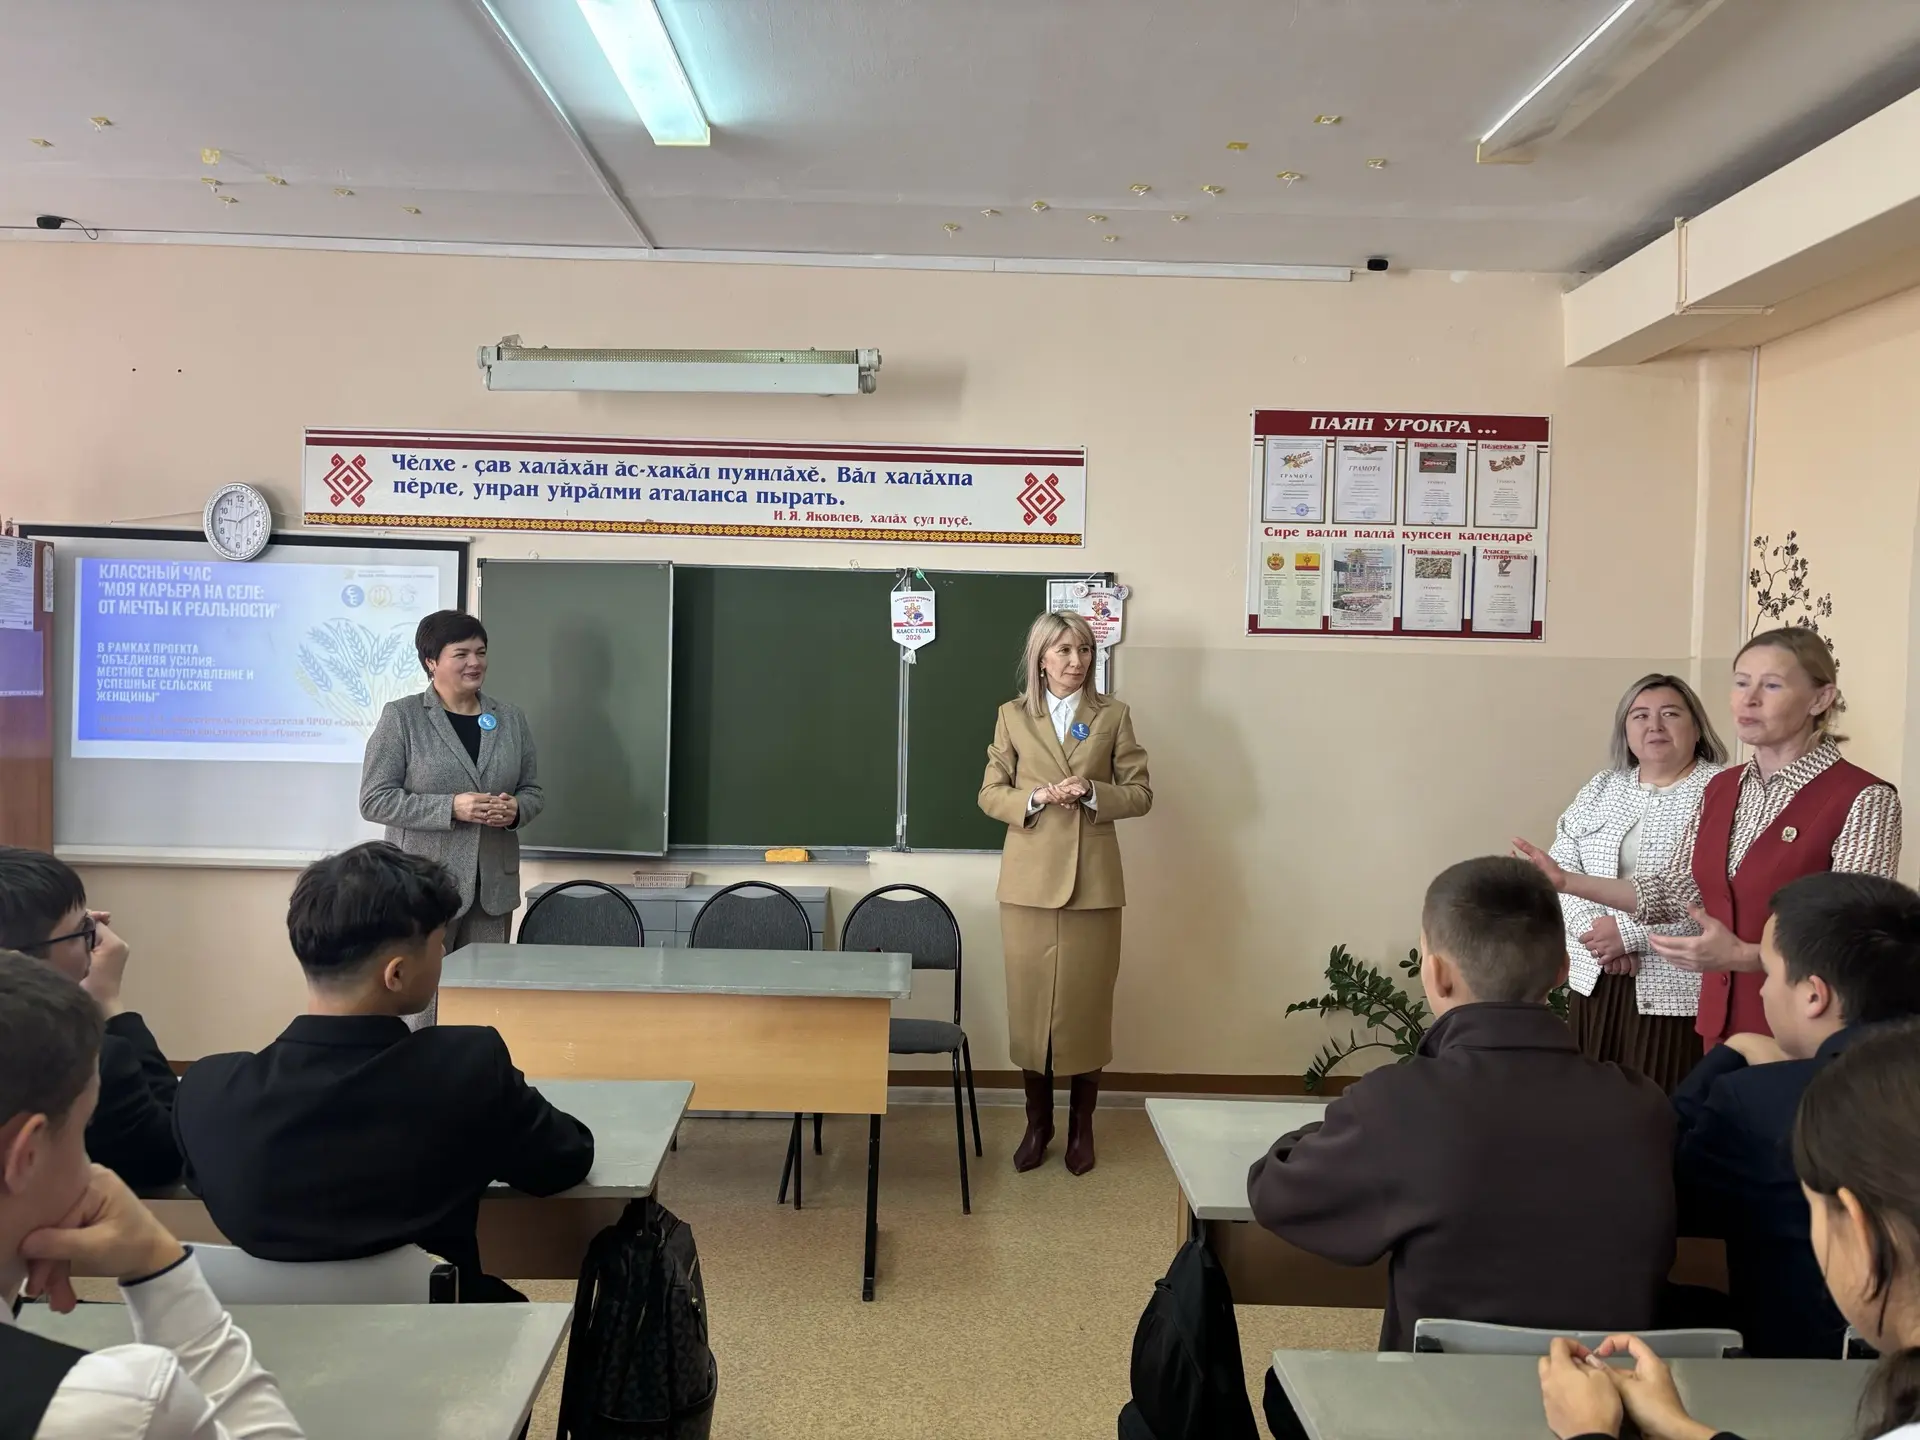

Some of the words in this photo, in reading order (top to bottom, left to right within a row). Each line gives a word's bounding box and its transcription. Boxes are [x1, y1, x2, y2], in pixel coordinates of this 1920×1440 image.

[1309, 416, 1375, 431] ПАЯН
[1384, 418, 1472, 434] УРОКРА
[473, 482, 539, 500] унран
[649, 487, 747, 503] аталанса
[756, 490, 846, 510] пырать.
[806, 511, 864, 524] Яковлев,
[1264, 526, 1300, 540] Сире
[1306, 528, 1348, 538] валли
[1402, 530, 1452, 542] кунсен
[99, 562, 180, 581] КЛАССНЫЙ
[183, 566, 212, 581] ЧАС
[140, 582, 200, 598] КАРЬЕРА
[204, 584, 224, 600] НА
[227, 584, 264, 600] СЕЛЕ:
[98, 600, 116, 615] ОТ
[118, 600, 168, 616] МЕЧТЫ
[172, 602, 182, 616] К
[97, 642, 105, 653] В
[108, 642, 150, 654] РАМКАХ
[154, 643, 199, 654] ПРОЕКТА
[170, 656, 216, 668] УСИЛИЯ:
[96, 666, 144, 678] МЕСТНОЕ
[147, 667, 244, 680] САМОУПРАВЛЕНИЕ
[246, 670, 254, 680] И
[96, 678, 157, 690] УСПЕШНЫЕ
[160, 680, 213, 692] СЕЛЬСКИЕ
